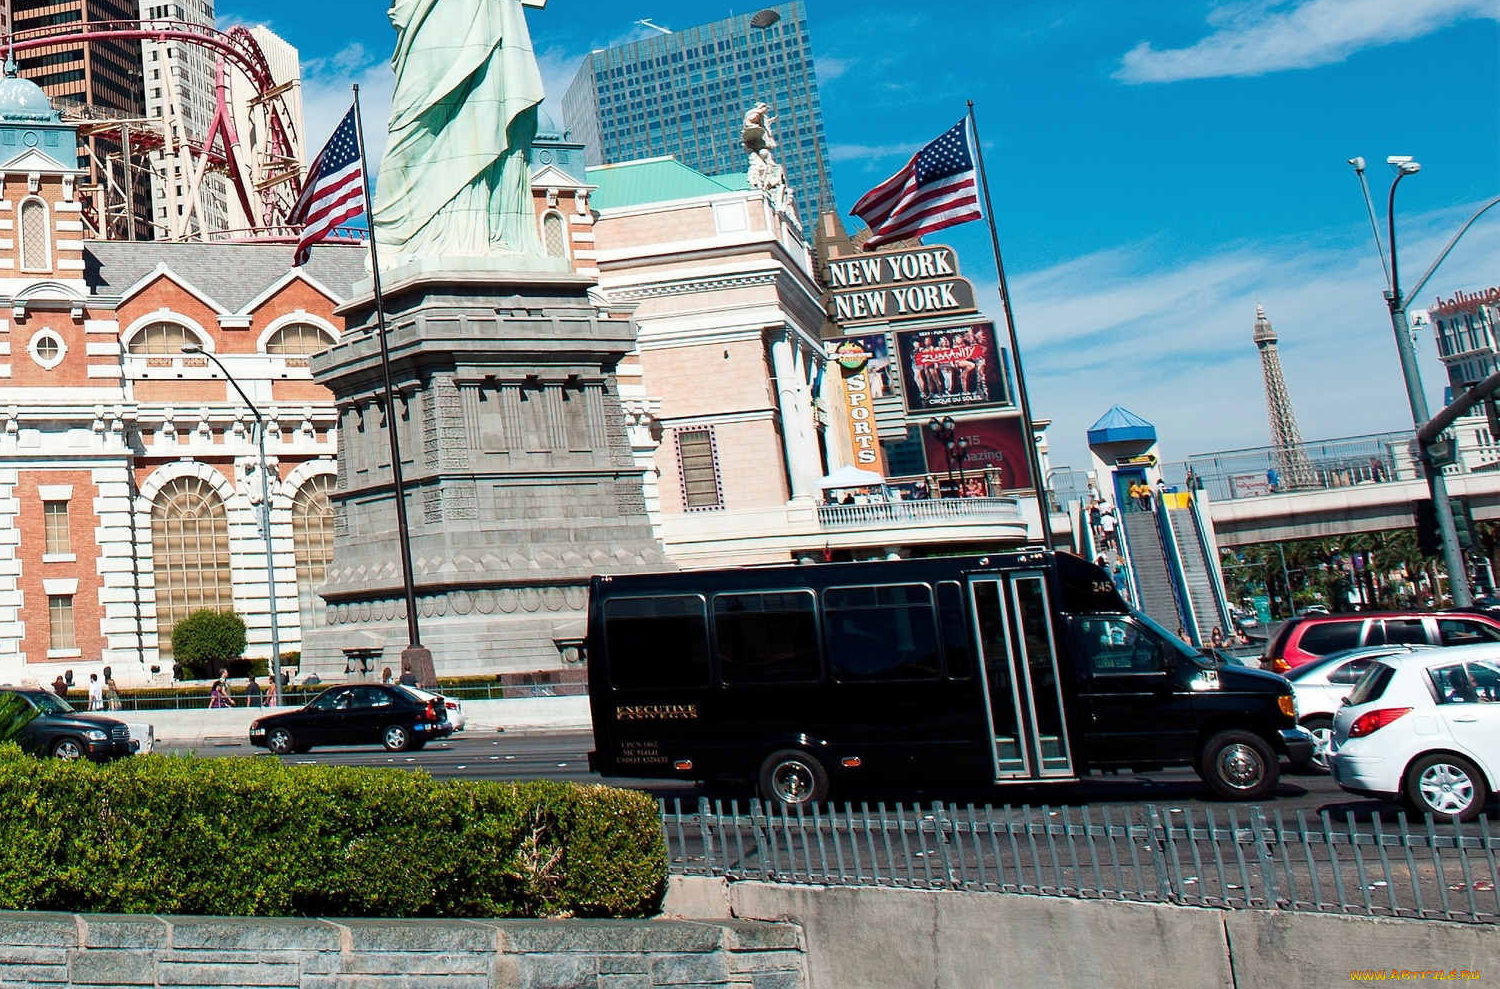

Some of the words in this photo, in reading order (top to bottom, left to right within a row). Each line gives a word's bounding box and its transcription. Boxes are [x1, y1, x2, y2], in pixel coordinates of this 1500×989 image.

[828, 258, 882, 287] NEW
[886, 250, 954, 280] YORK
[833, 290, 887, 320] NEW
[891, 283, 960, 313] YORK
[1436, 287, 1500, 316] hollywo
[921, 346, 975, 363] ZUMANITY
[929, 397, 952, 405] CIRQUE
[846, 373, 877, 464] SPORTS
[1091, 581, 1112, 592] 245
[616, 705, 697, 713] EXECUTIVE
